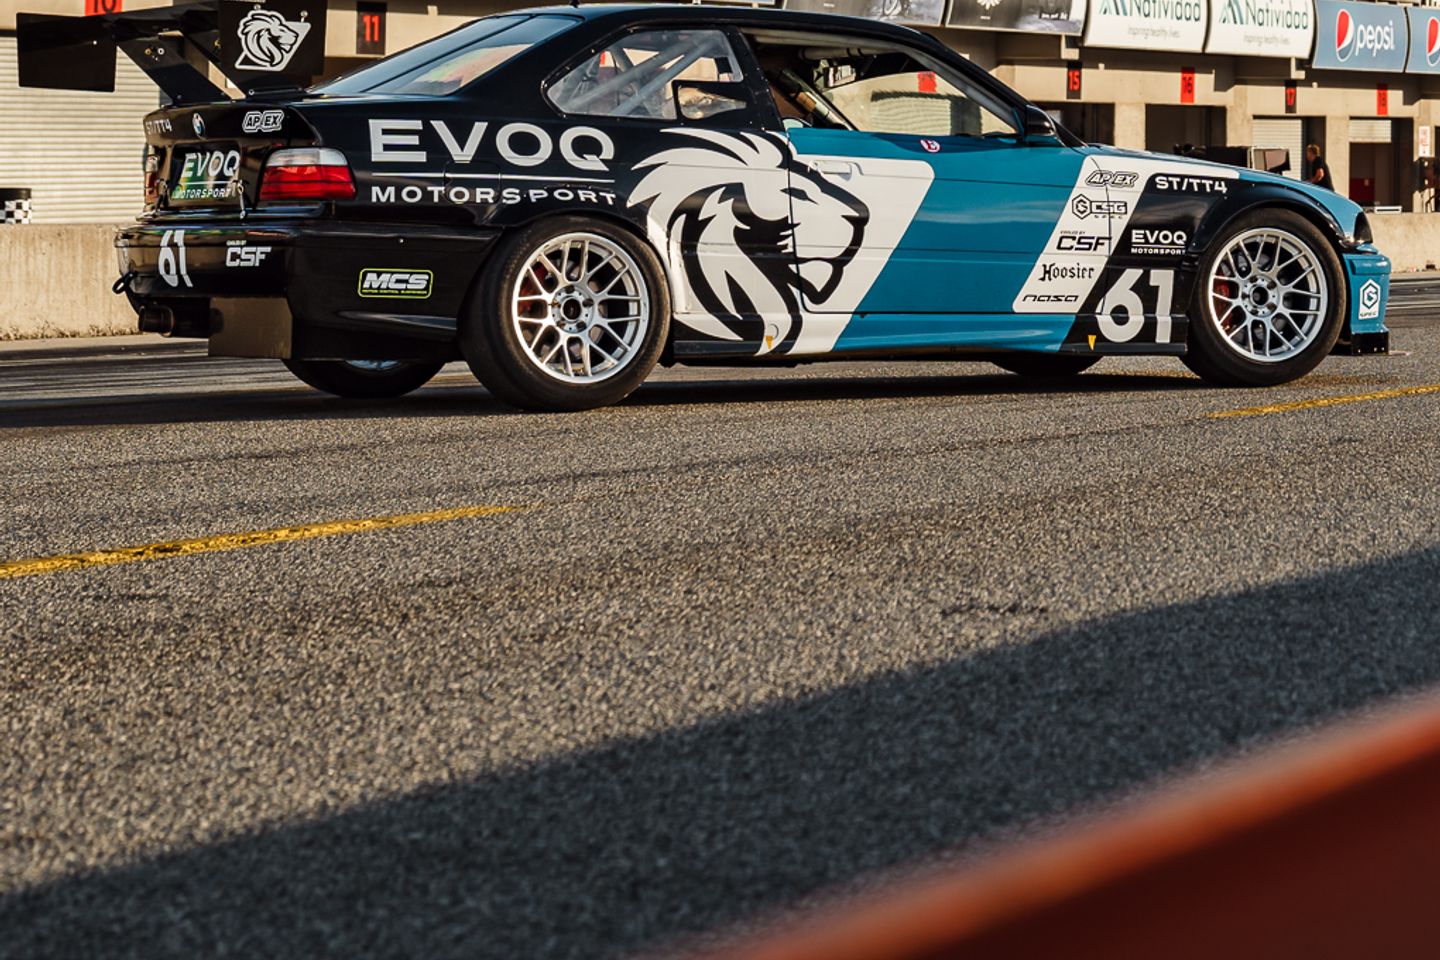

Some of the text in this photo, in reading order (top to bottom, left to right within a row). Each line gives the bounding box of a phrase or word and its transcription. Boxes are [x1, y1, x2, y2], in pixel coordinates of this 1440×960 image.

[362, 15, 380, 43] 11
[1356, 21, 1395, 57] pepsi
[1067, 69, 1080, 91] 15
[1183, 76, 1194, 95] 16
[242, 110, 285, 133] APEX
[368, 119, 615, 171] EVOQ
[180, 149, 240, 178] EVOQ
[1085, 170, 1139, 188] APEX
[1155, 176, 1228, 194] ST/TT4
[171, 187, 237, 200] MOTORSPORT
[371, 186, 617, 206] MOTORSPORT
[1094, 202, 1127, 213] CSG
[1056, 236, 1112, 252] CSF
[1131, 230, 1187, 245] EVOQ
[158, 230, 194, 288] 61
[226, 246, 272, 267] CSF
[1131, 247, 1186, 256] MOTORSPORT
[363, 273, 429, 289] MCS
[1038, 262, 1095, 282] Hoosier
[1022, 294, 1079, 303] nasa
[1095, 268, 1175, 343] 61
